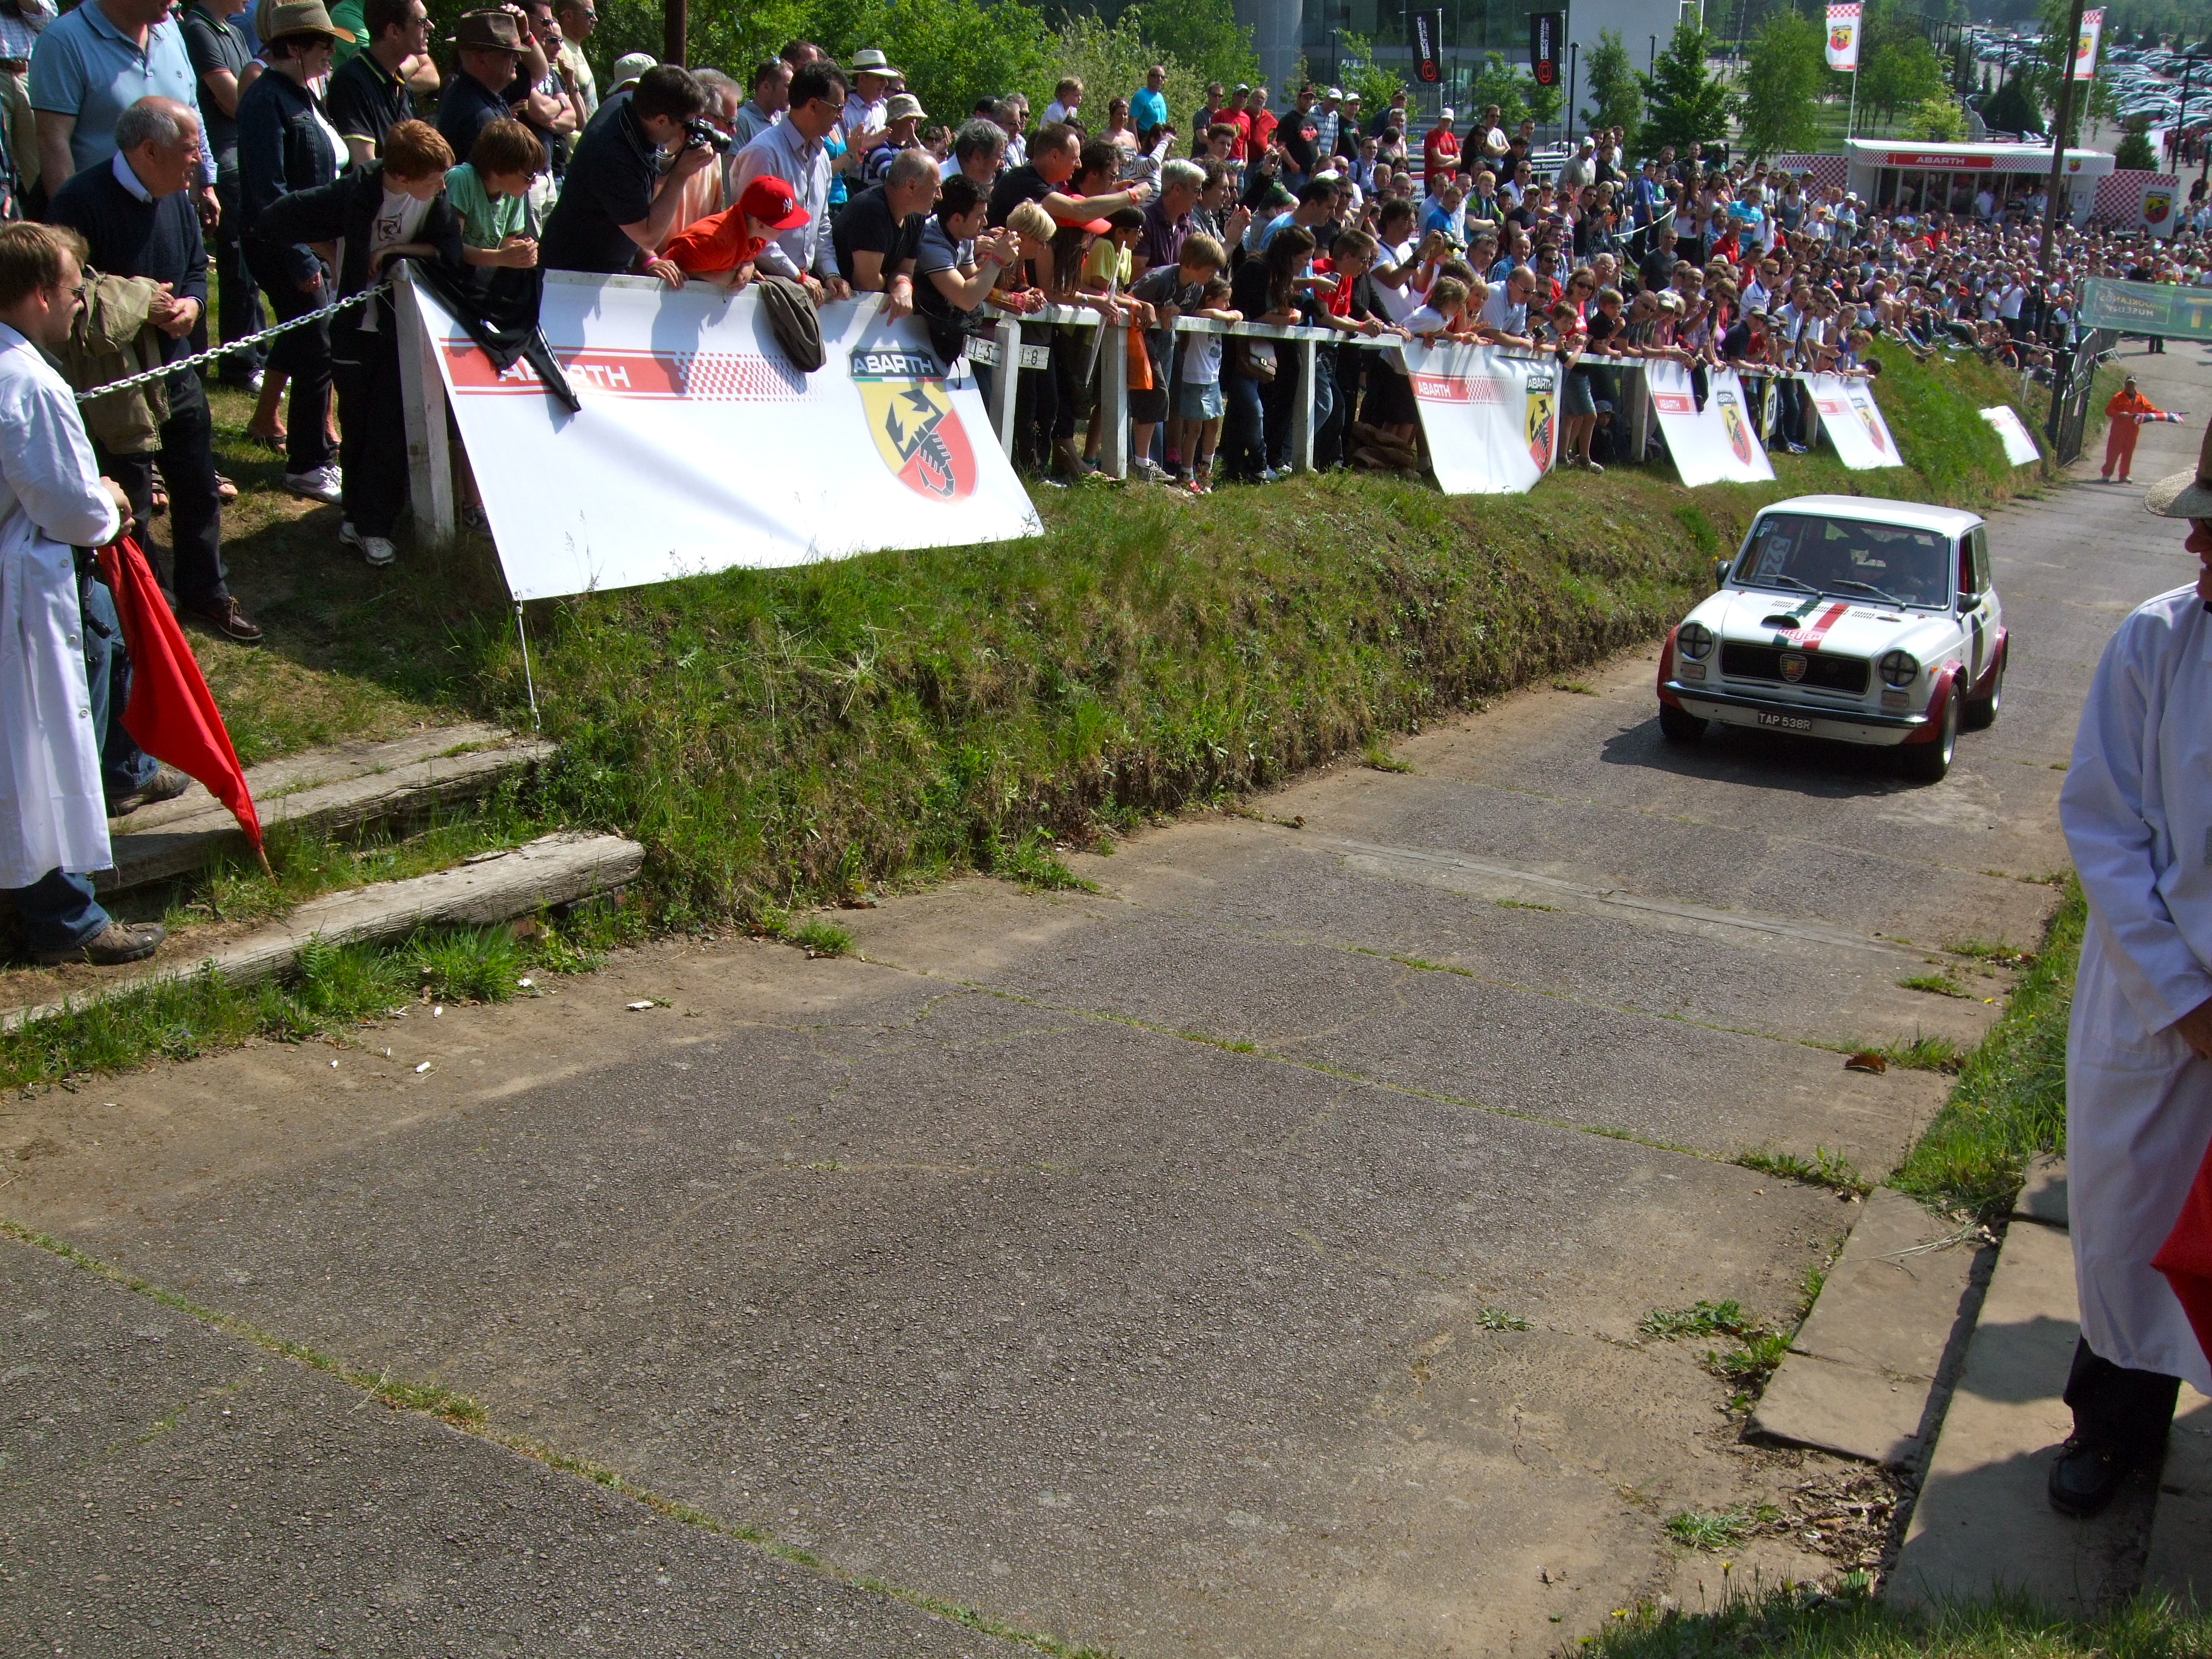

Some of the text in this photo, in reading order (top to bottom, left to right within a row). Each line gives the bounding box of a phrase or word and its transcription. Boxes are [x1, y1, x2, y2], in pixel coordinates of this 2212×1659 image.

[1417, 16, 1427, 59] PERFORMANCE
[1916, 156, 1965, 165] ABARTH
[854, 354, 935, 373] ABARTH
[1021, 348, 1038, 365] 1:8
[499, 357, 632, 388] ARTH
[1417, 382, 1452, 397] ABARTH
[1528, 377, 1552, 390] ABARTH
[1660, 399, 1681, 410] ABARTH
[1718, 392, 1736, 404] ABARTH
[1767, 393, 1775, 422] 13
[1781, 629, 1820, 640] HEUER
[1759, 713, 1811, 730] TAP 538R
